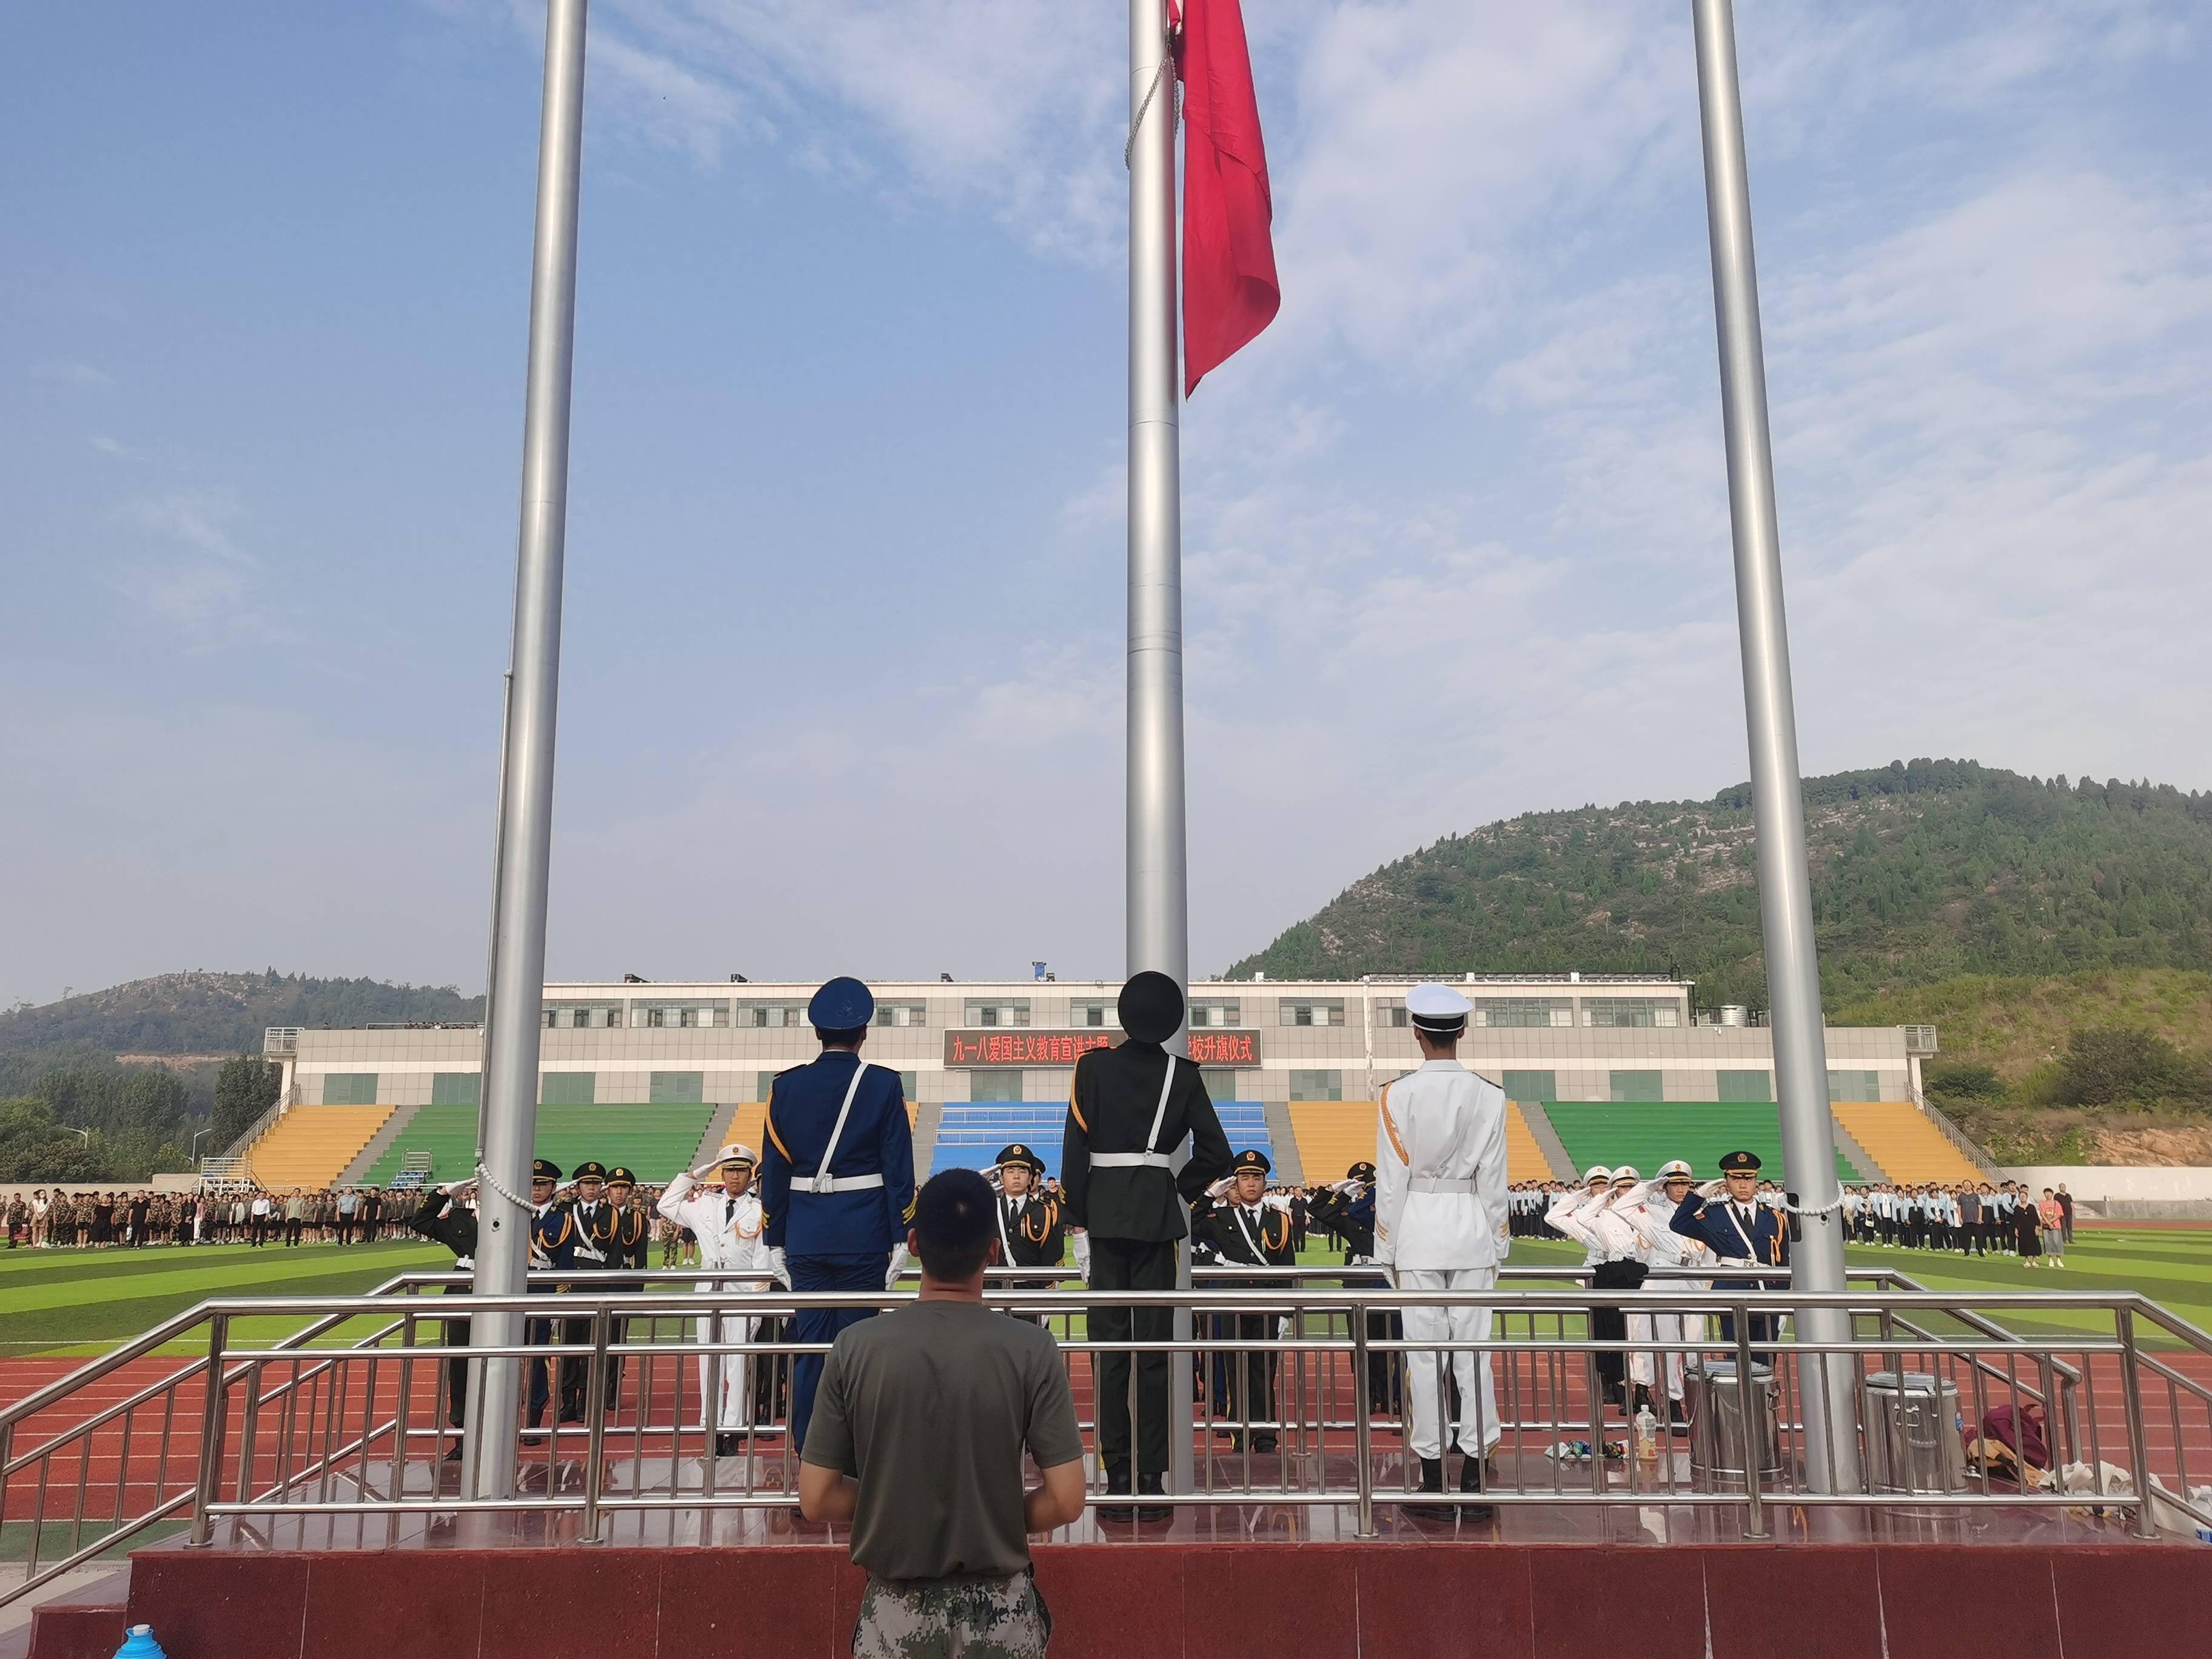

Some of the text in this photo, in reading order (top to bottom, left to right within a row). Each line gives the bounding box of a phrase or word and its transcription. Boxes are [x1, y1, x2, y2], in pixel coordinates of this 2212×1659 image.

[1188, 1034, 1252, 1062] 校升旗仪式
